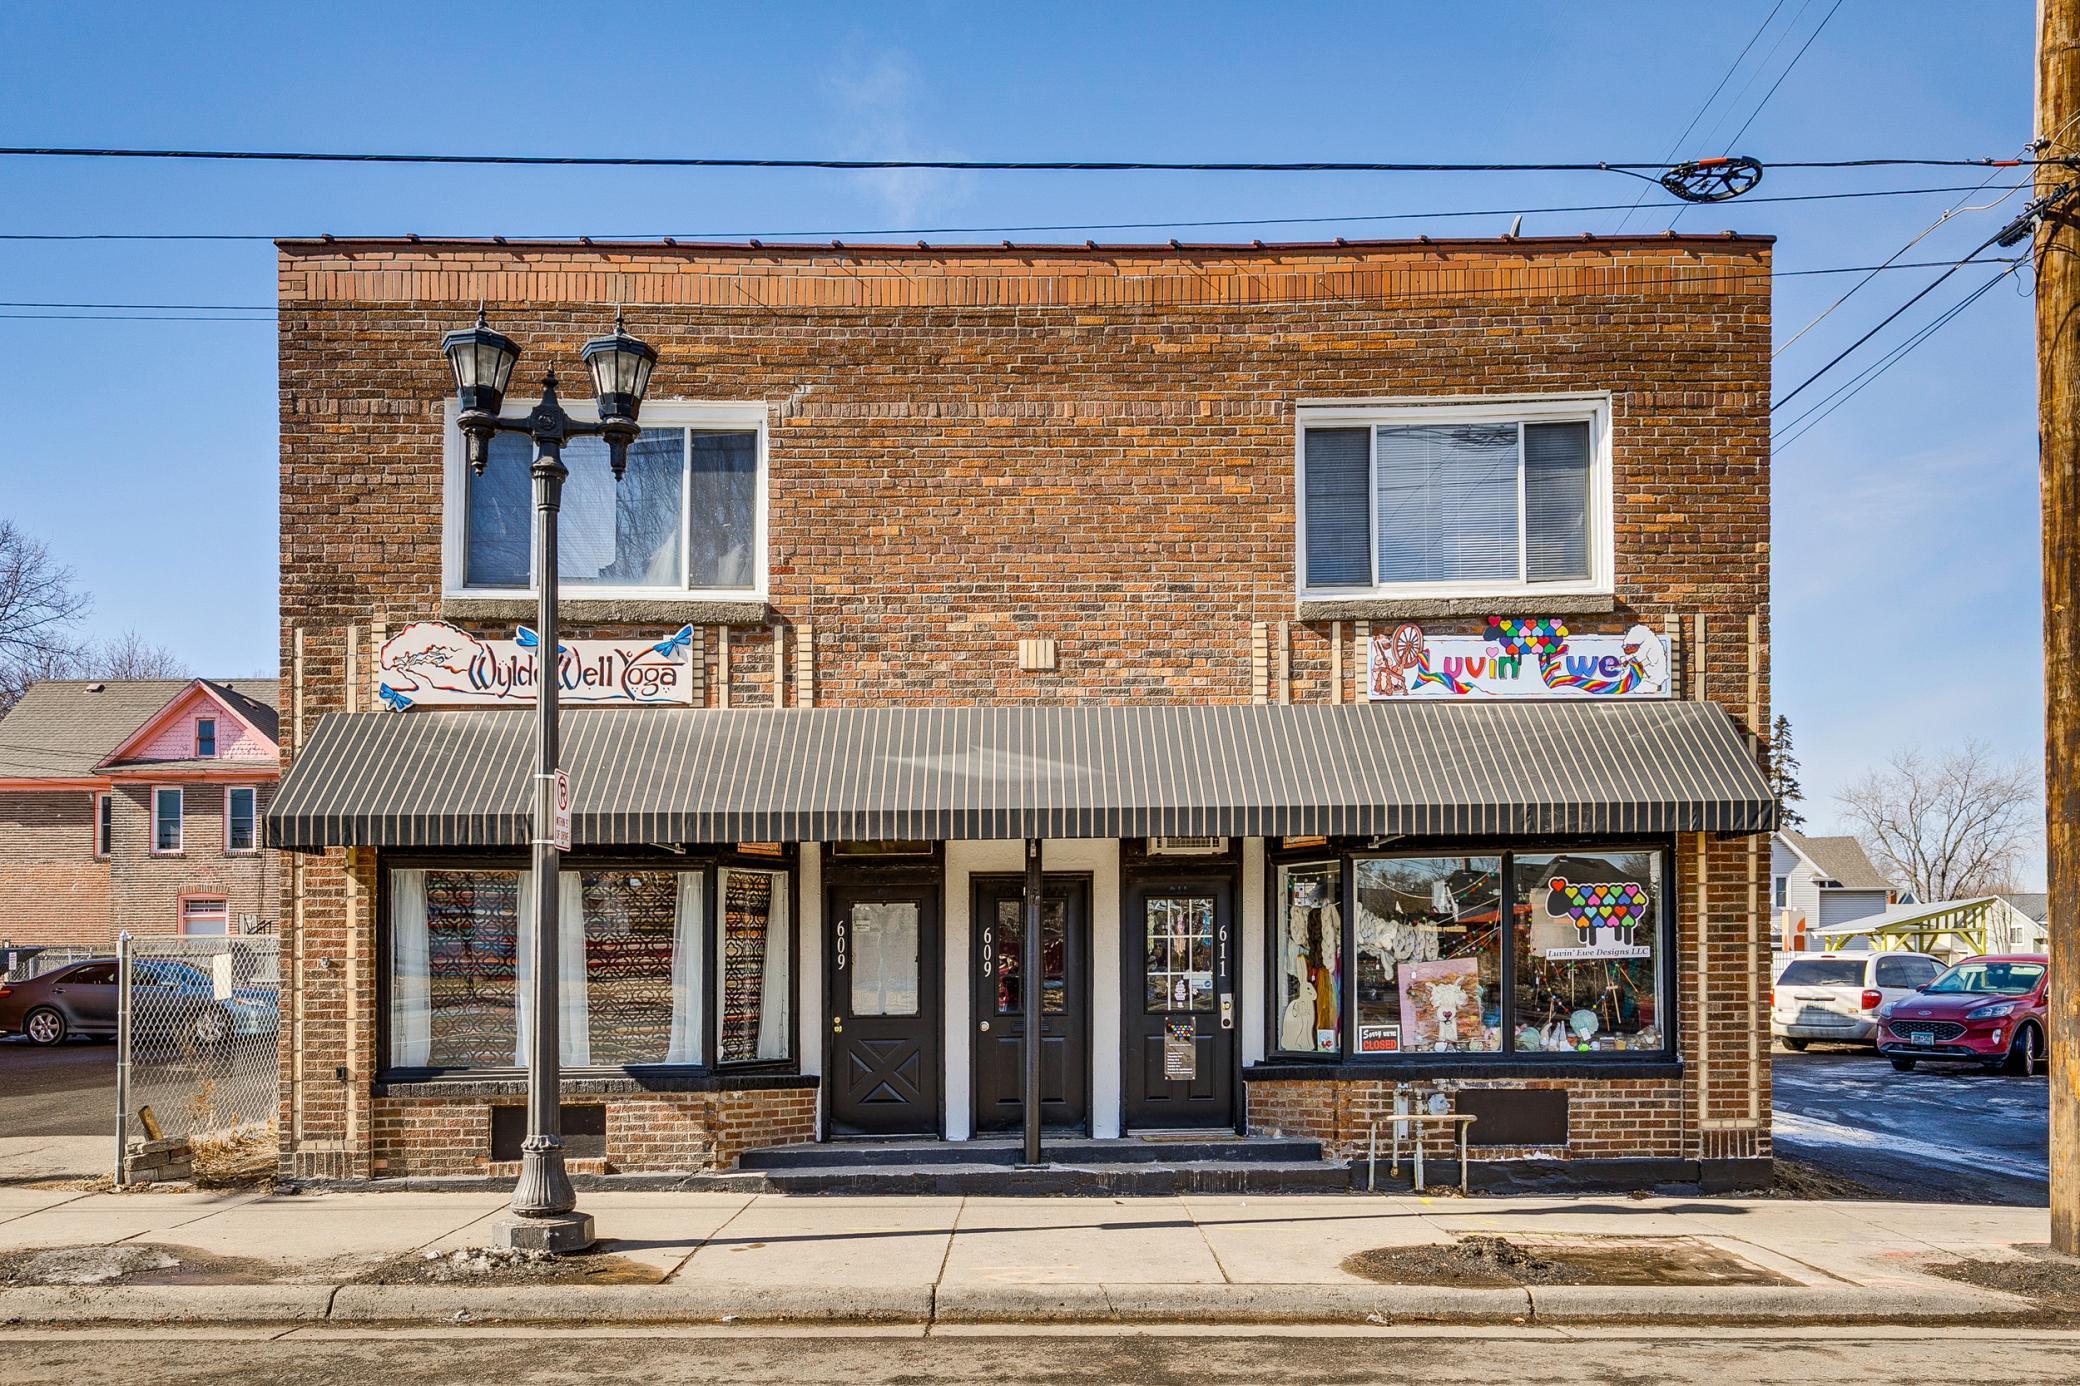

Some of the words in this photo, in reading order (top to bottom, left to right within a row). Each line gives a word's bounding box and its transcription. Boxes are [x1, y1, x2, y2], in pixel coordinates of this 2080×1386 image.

[468, 643, 538, 699] Wyld
[557, 646, 613, 690] Well
[613, 645, 682, 701] Yoga
[1540, 645, 1621, 689] Ewe
[837, 920, 846, 970] 609
[983, 927, 992, 978] 609
[1218, 924, 1227, 977] 611
[1577, 949, 1595, 957] Ewe
[1597, 947, 1630, 957] Designs
[1632, 947, 1649, 955] LLC
[1363, 1029, 1381, 1039] Sorry
[1363, 1040, 1397, 1050] CLOSED
